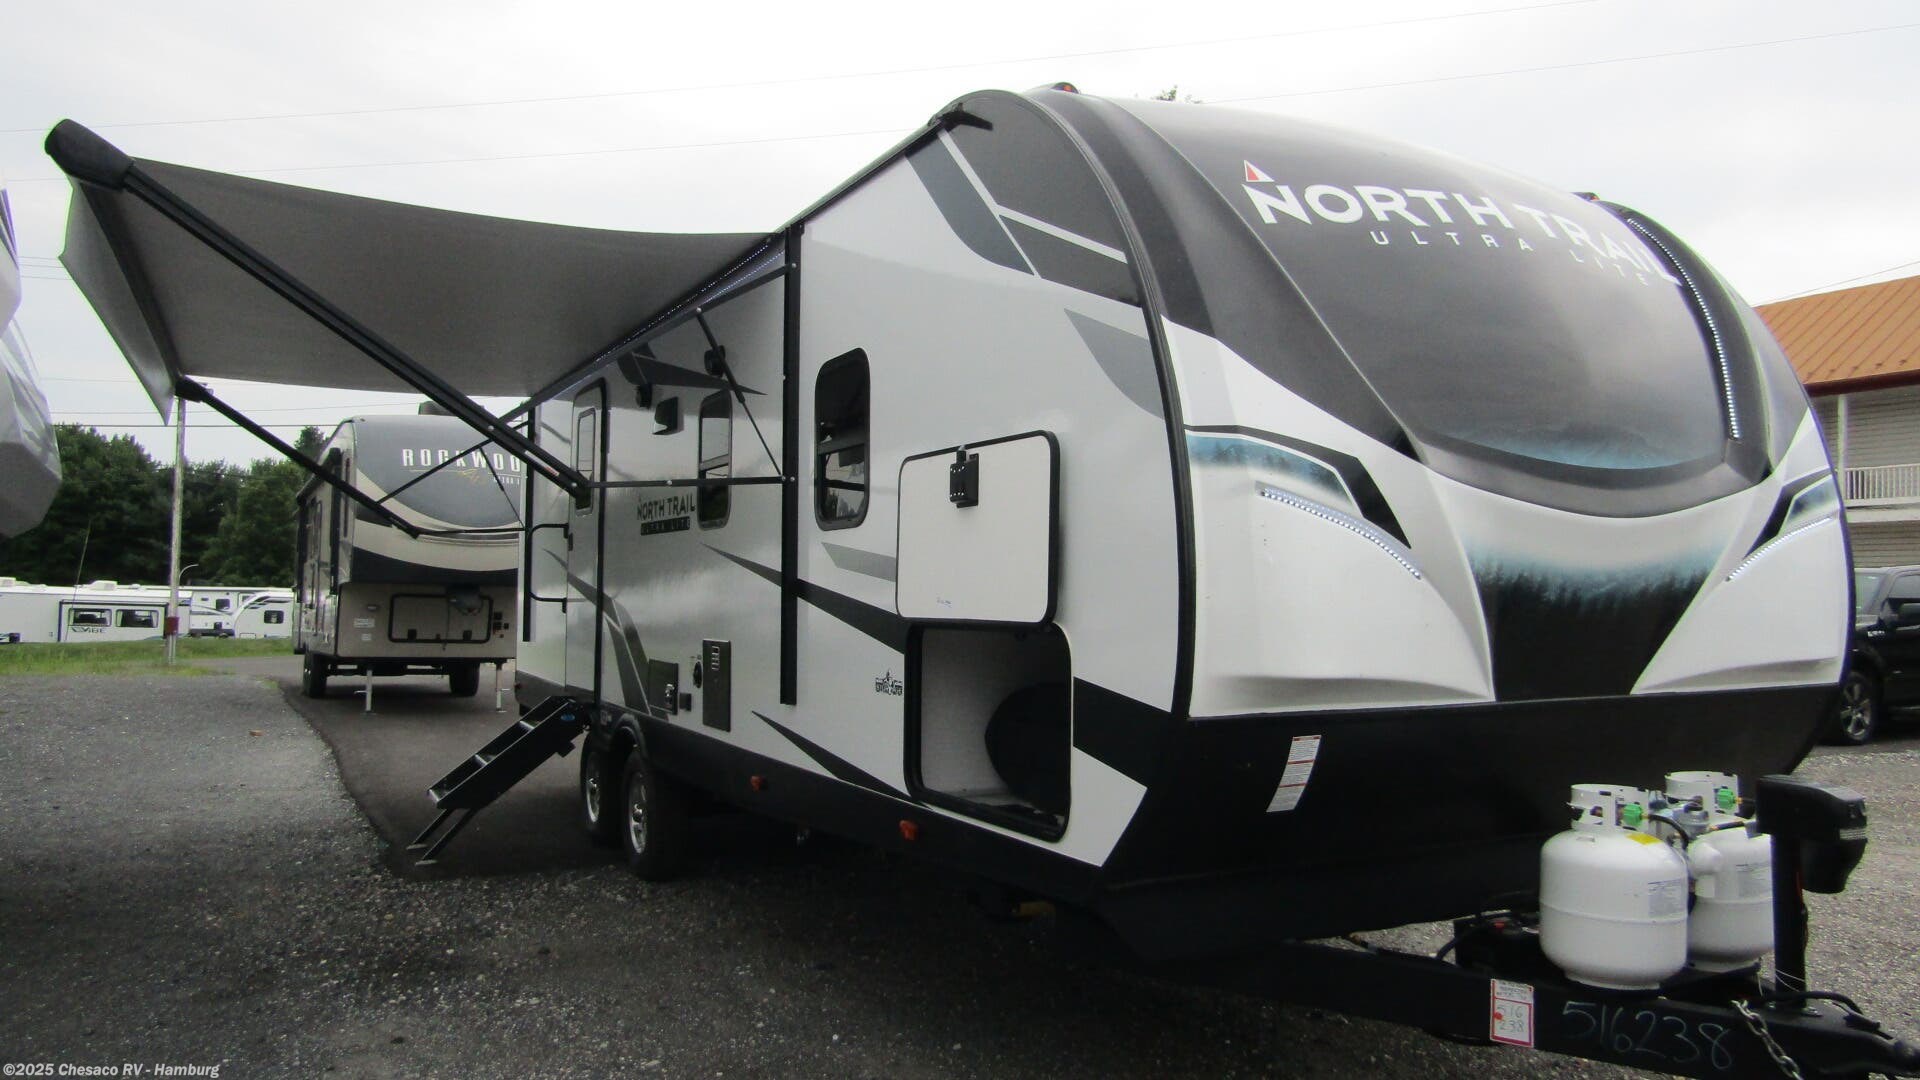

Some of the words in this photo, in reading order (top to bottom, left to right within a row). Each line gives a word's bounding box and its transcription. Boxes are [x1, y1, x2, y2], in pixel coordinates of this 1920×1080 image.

[1242, 184, 1515, 229] NORTH
[1513, 203, 1682, 287] TRAIL
[1370, 231, 1536, 253] ULTRA
[1570, 249, 1649, 286] LITE
[402, 448, 521, 472] ROCKWOO
[637, 499, 665, 520] NORTH
[667, 494, 695, 516] TRAIL
[1562, 1000, 1731, 1070] 516238
